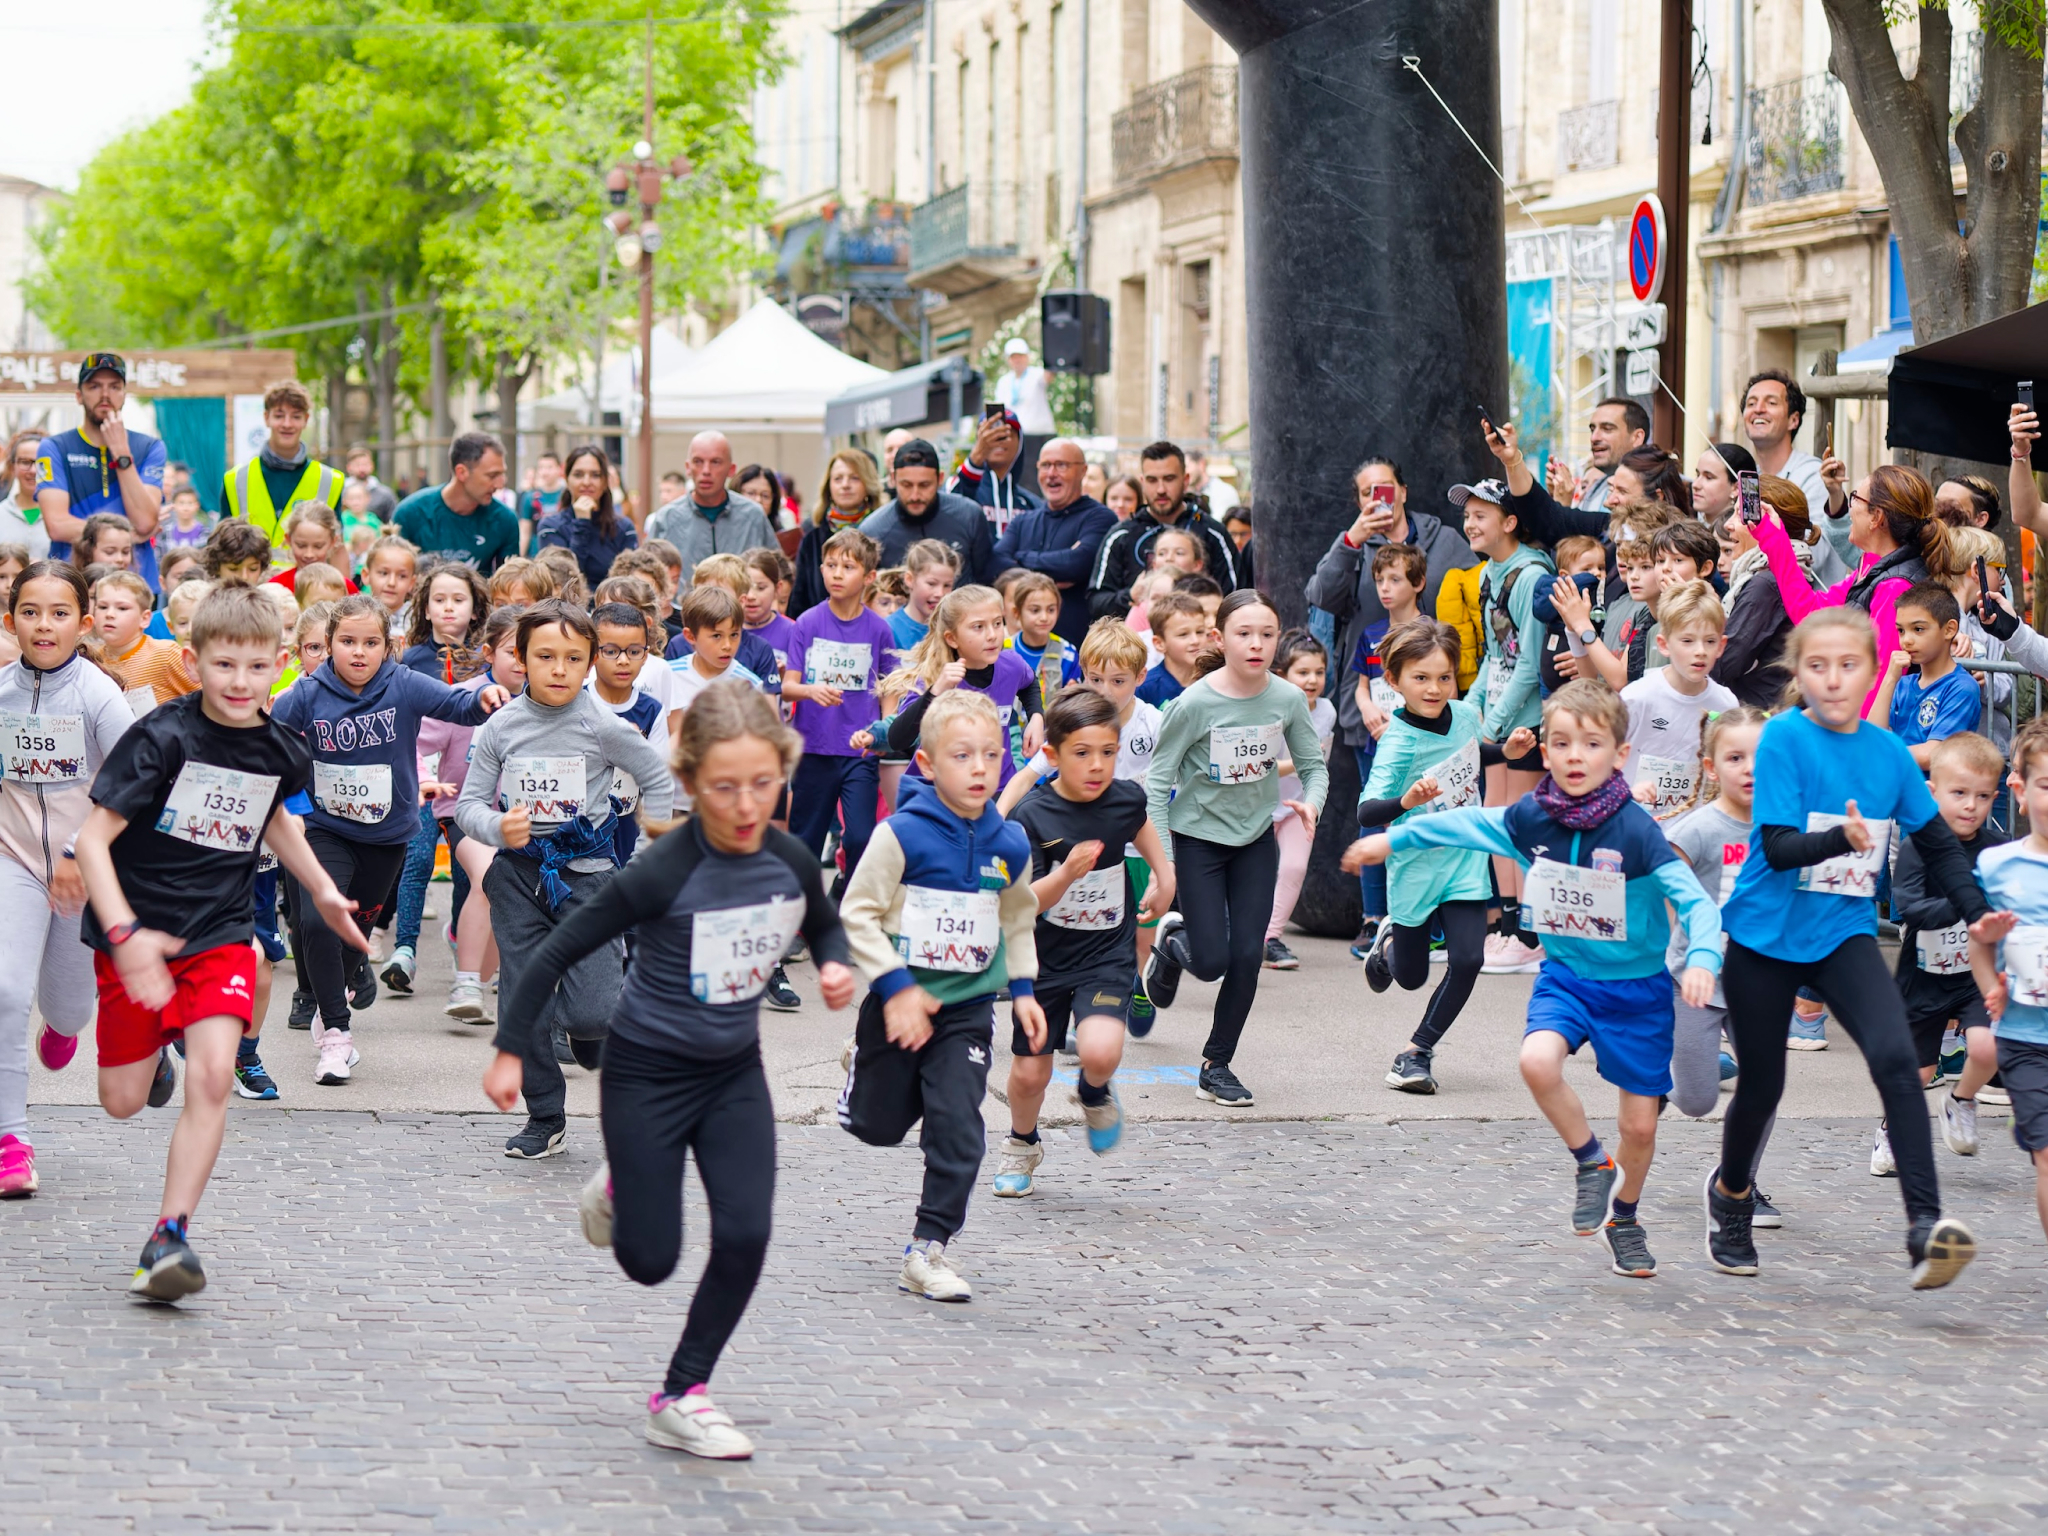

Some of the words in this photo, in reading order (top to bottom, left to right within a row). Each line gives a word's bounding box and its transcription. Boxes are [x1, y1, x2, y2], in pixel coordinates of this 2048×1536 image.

[828, 657, 855, 668] 1349
[1378, 692, 1396, 701] 1419
[314, 707, 396, 752] ROXY
[15, 735, 56, 752] 1358
[1234, 744, 1267, 758] 1369
[1449, 762, 1473, 787] 1328
[333, 784, 368, 796] 1330
[520, 779, 559, 792] 1342
[1658, 777, 1690, 789] 1338
[204, 793, 248, 814] 1335
[1069, 888, 1108, 902] 1364
[1550, 887, 1594, 908] 1336
[936, 917, 975, 935] 1341
[1940, 930, 1969, 945] 130
[731, 933, 781, 958] 1363
